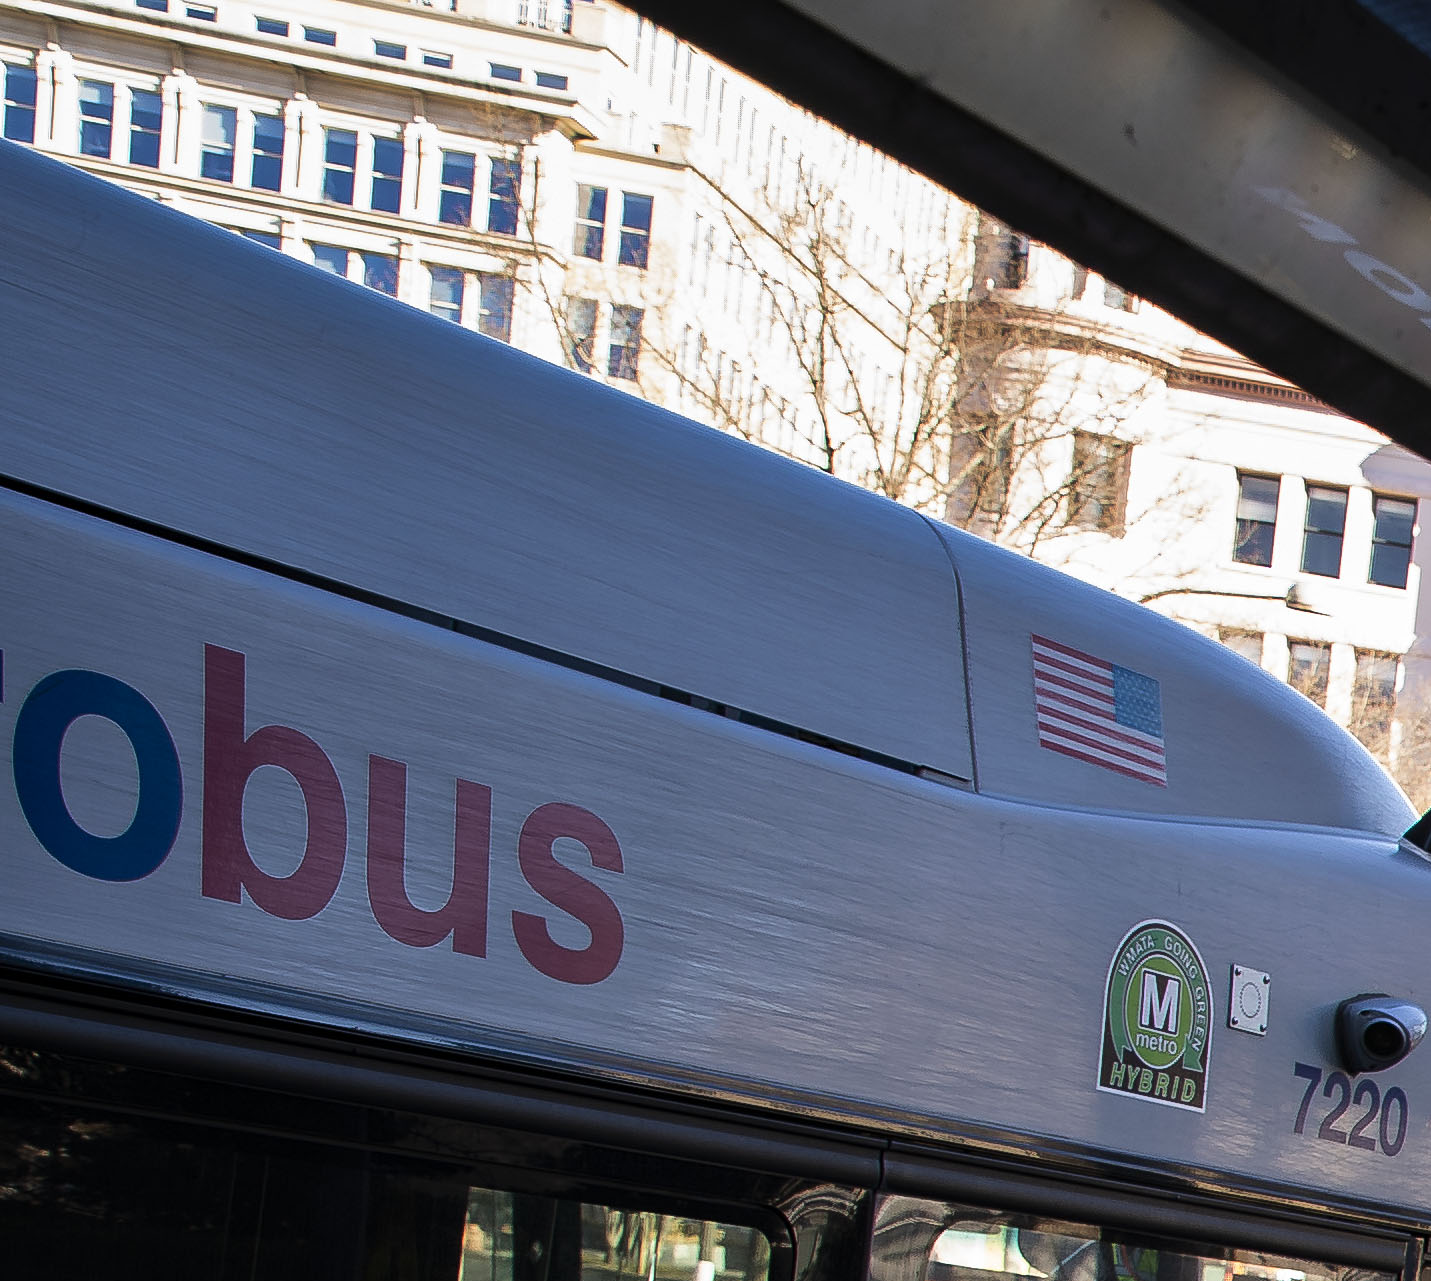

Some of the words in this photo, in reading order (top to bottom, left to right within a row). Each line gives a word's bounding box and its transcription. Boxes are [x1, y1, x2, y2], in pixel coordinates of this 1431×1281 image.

[0, 643, 625, 985] obus
[1118, 935, 1156, 976] WMATA
[1164, 936, 1198, 979] GOING
[1191, 986, 1208, 1052] GREEN
[1141, 972, 1180, 1033] M
[1109, 1061, 1197, 1102] HYBRID
[1135, 1032, 1178, 1056] metro
[1292, 1062, 1409, 1157] 7220
